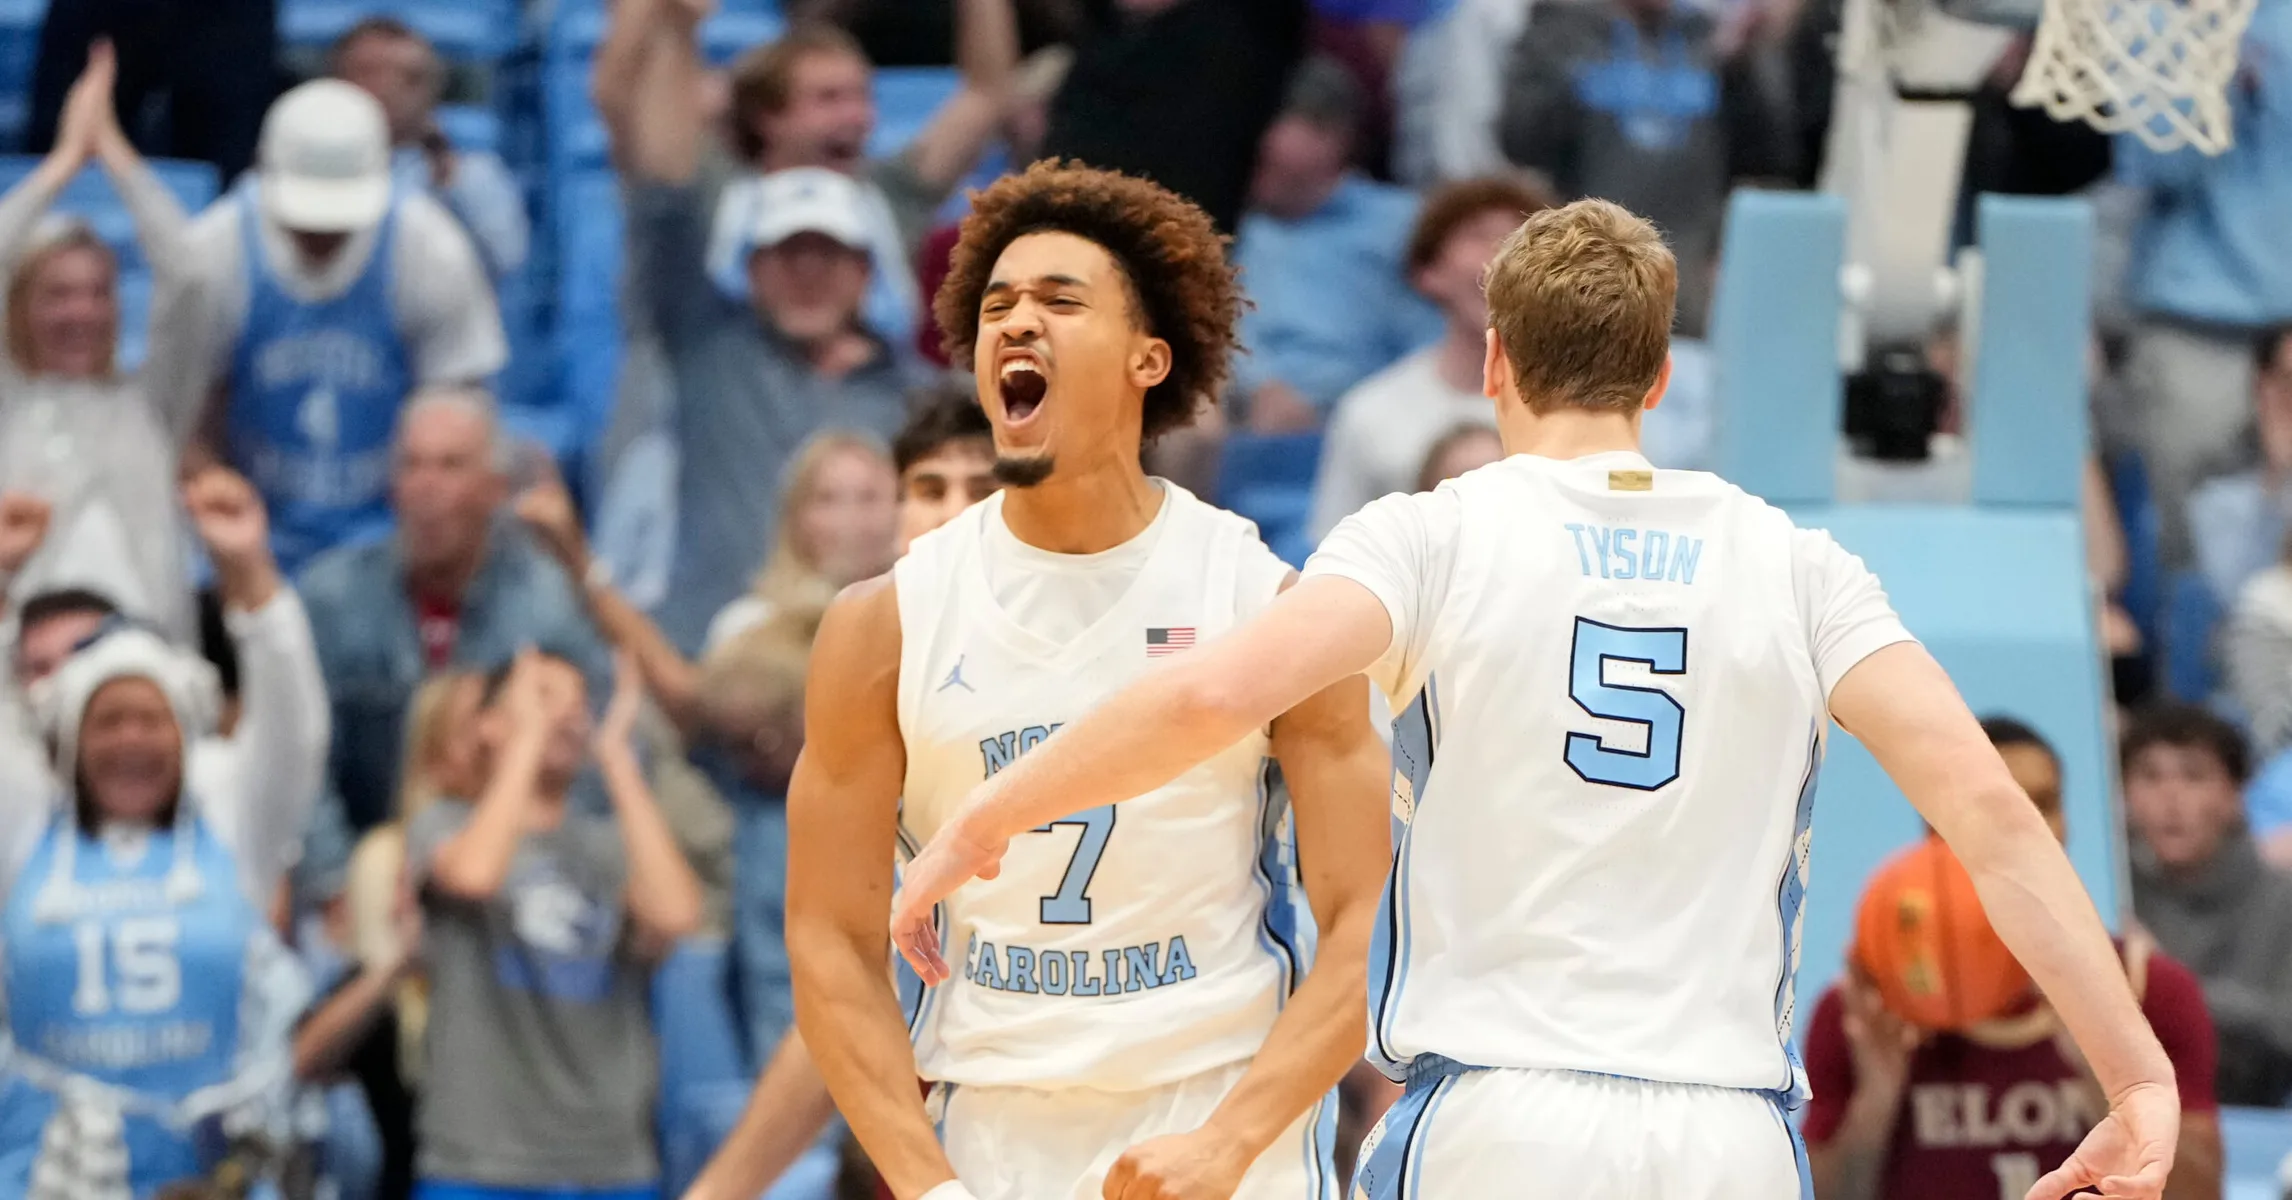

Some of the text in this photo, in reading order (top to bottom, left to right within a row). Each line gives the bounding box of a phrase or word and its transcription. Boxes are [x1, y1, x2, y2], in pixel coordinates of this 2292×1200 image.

[1564, 523, 1704, 585] TYSON
[980, 723, 1065, 780] NO
[1563, 615, 1688, 791] 5
[1026, 804, 1117, 925] 7
[72, 917, 183, 1016] 15
